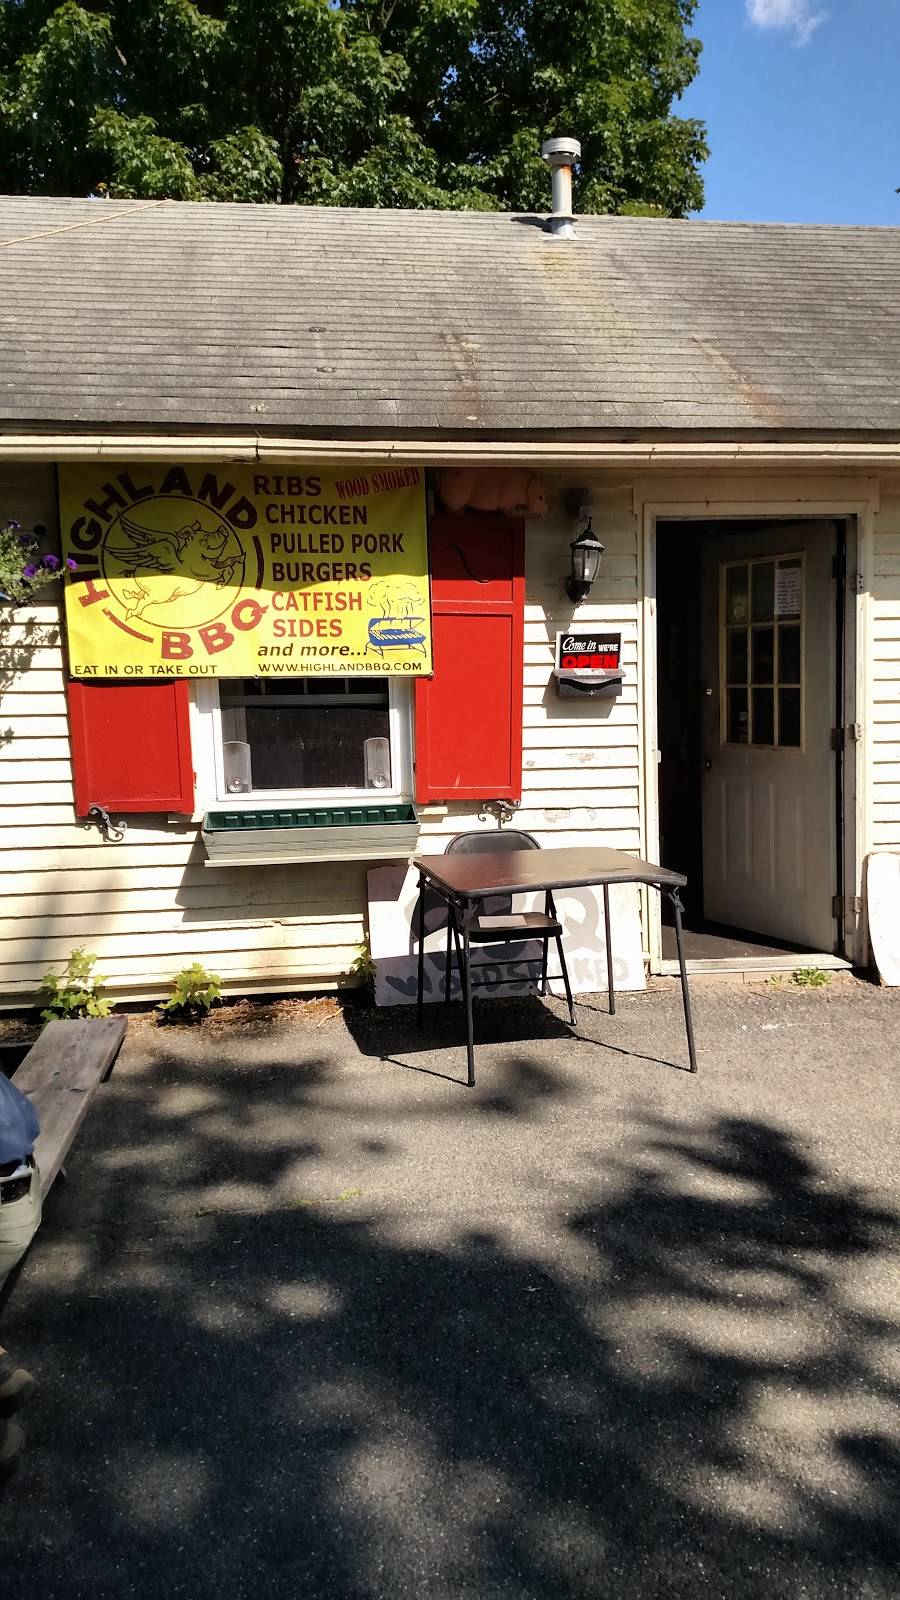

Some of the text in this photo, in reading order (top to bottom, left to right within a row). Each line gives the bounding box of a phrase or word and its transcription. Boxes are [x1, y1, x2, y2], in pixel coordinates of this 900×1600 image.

[253, 475, 322, 497] RIBS
[335, 466, 421, 500] WOOD SMOKED
[265, 503, 368, 525] CHICKEN
[67, 466, 258, 609] HIGHLAND
[270, 533, 405, 554] PULLED PORK
[272, 562, 372, 582] BURGERS
[271, 591, 362, 612] CATFISH
[160, 598, 270, 660] BBQ
[272, 618, 343, 638] SIDES
[257, 642, 367, 657] and more...
[562, 636, 619, 652] Come in WE'RE
[74, 664, 217, 675] EAT IN OR TAKE OUT
[258, 662, 422, 673] WWW.HIGHLANDBBQ.COM
[562, 654, 619, 669] OPEN
